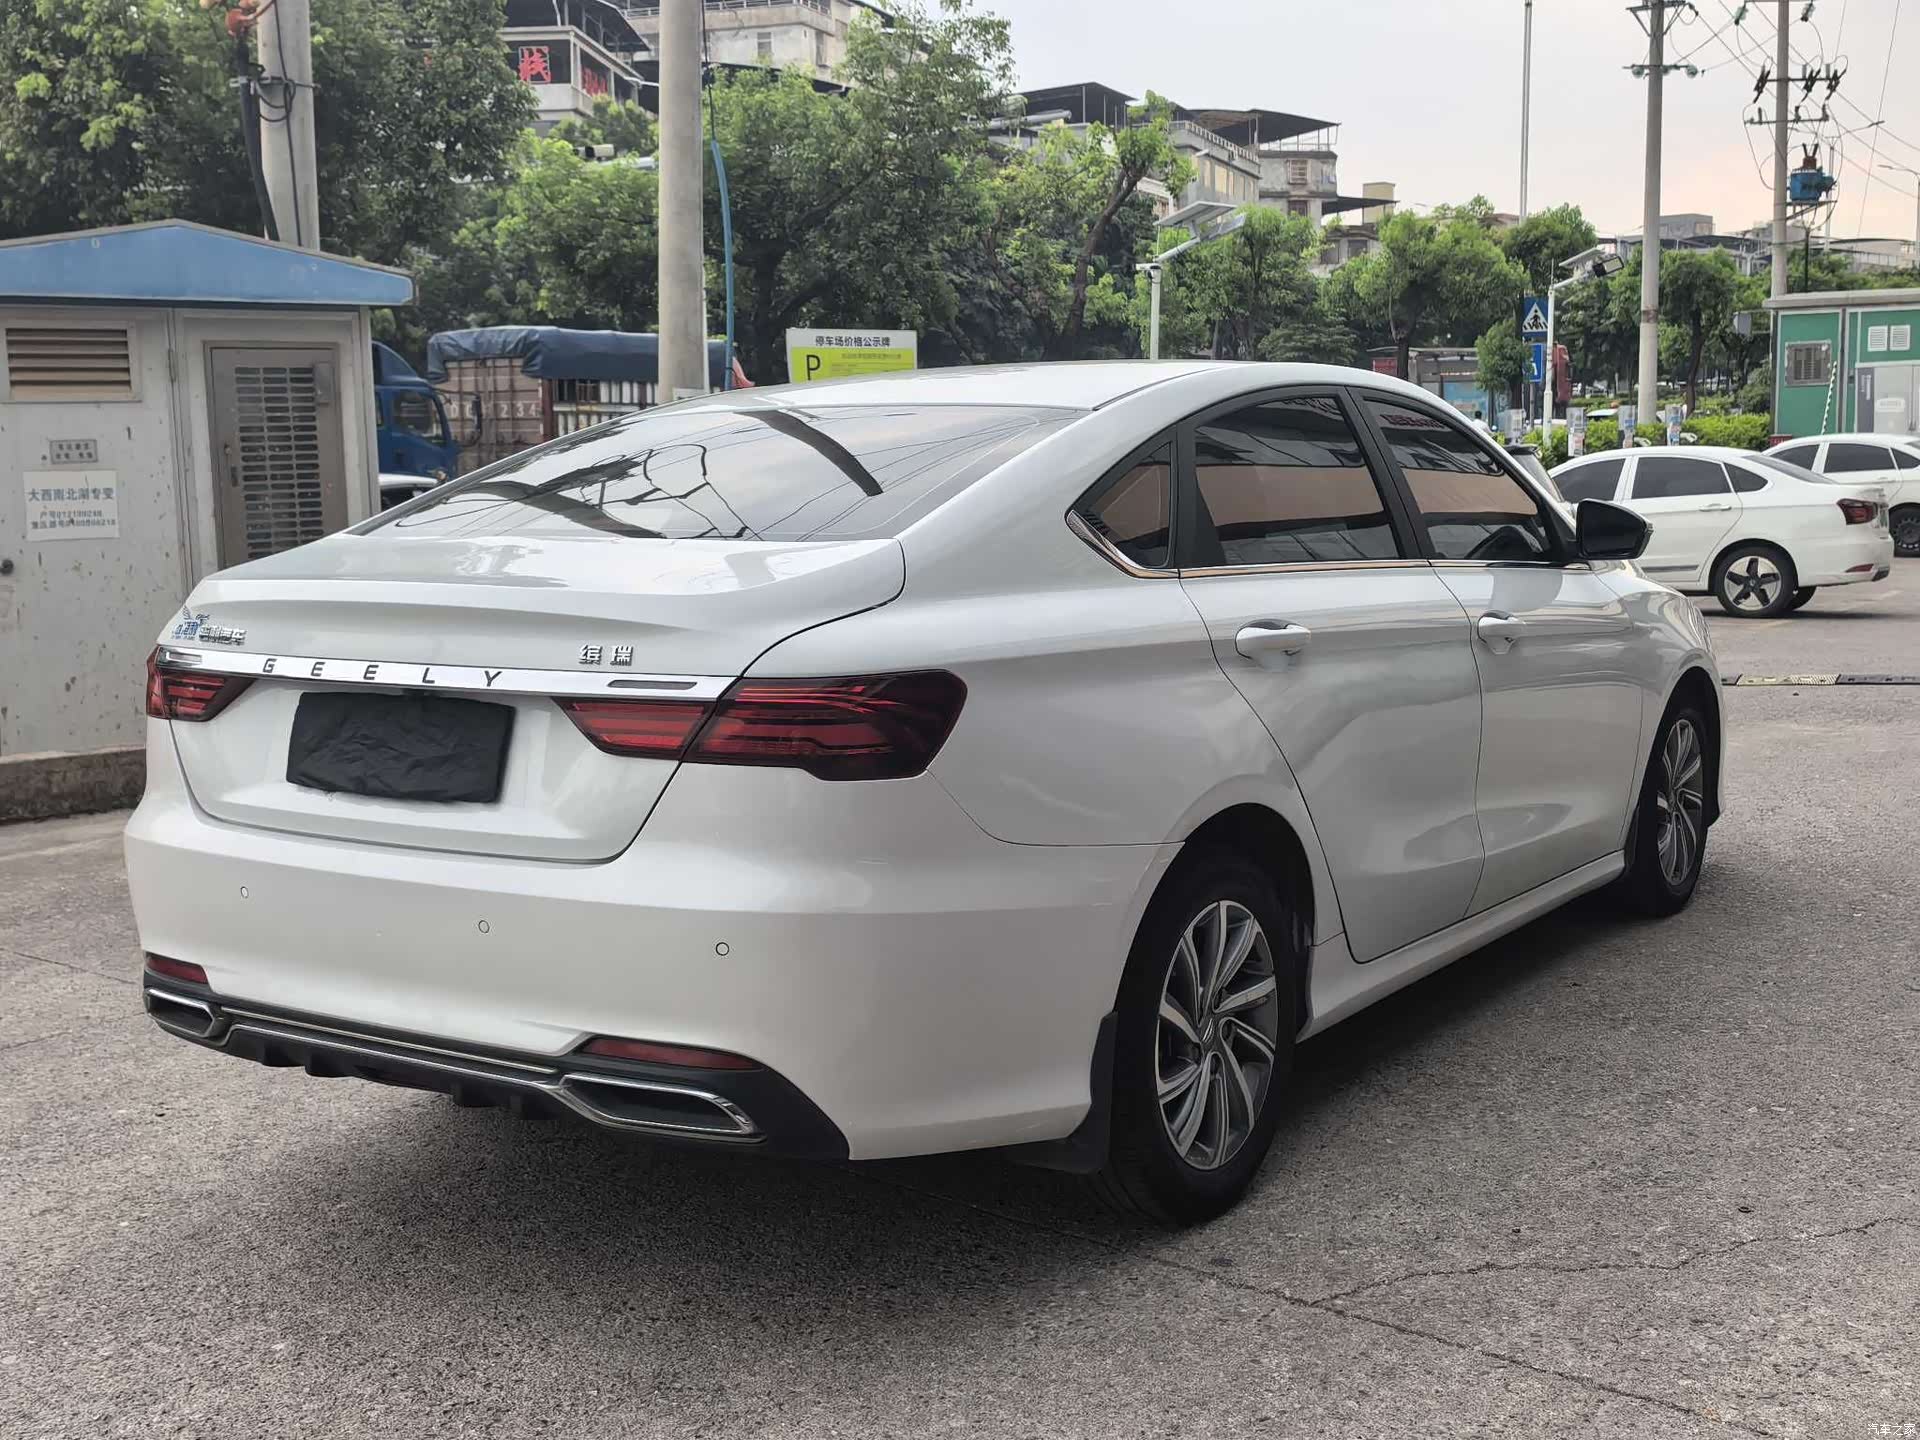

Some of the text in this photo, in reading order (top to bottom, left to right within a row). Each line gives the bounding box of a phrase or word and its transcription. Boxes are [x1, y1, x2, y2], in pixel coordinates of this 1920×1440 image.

[815, 335, 891, 347] 停车场价格公示牌
[805, 354, 821, 381] P
[579, 643, 634, 666] 缤瑞
[262, 656, 502, 688] GEELY
